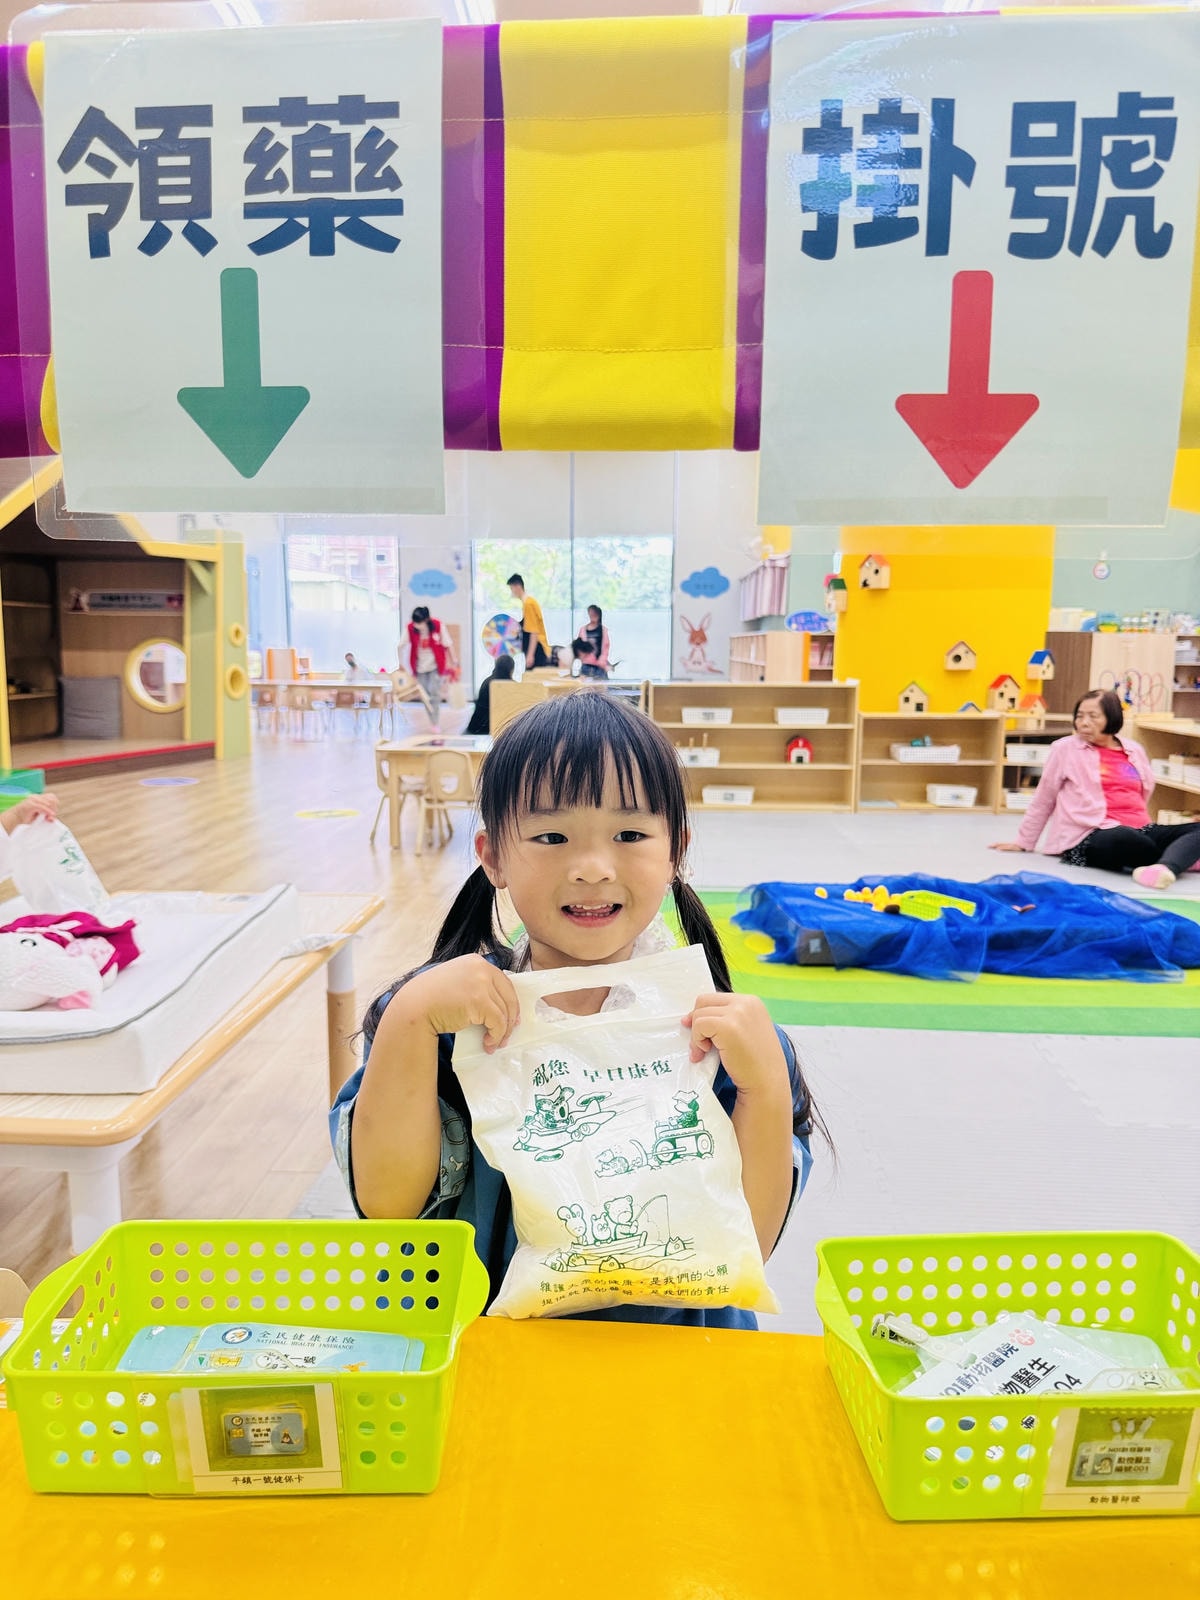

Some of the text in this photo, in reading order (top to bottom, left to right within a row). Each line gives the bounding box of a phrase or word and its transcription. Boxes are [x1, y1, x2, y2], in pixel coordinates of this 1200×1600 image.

[57, 95, 404, 259] 領藥
[800, 91, 1178, 261] 掛號
[231, 1475, 305, 1485] 平鎮一號健保卡
